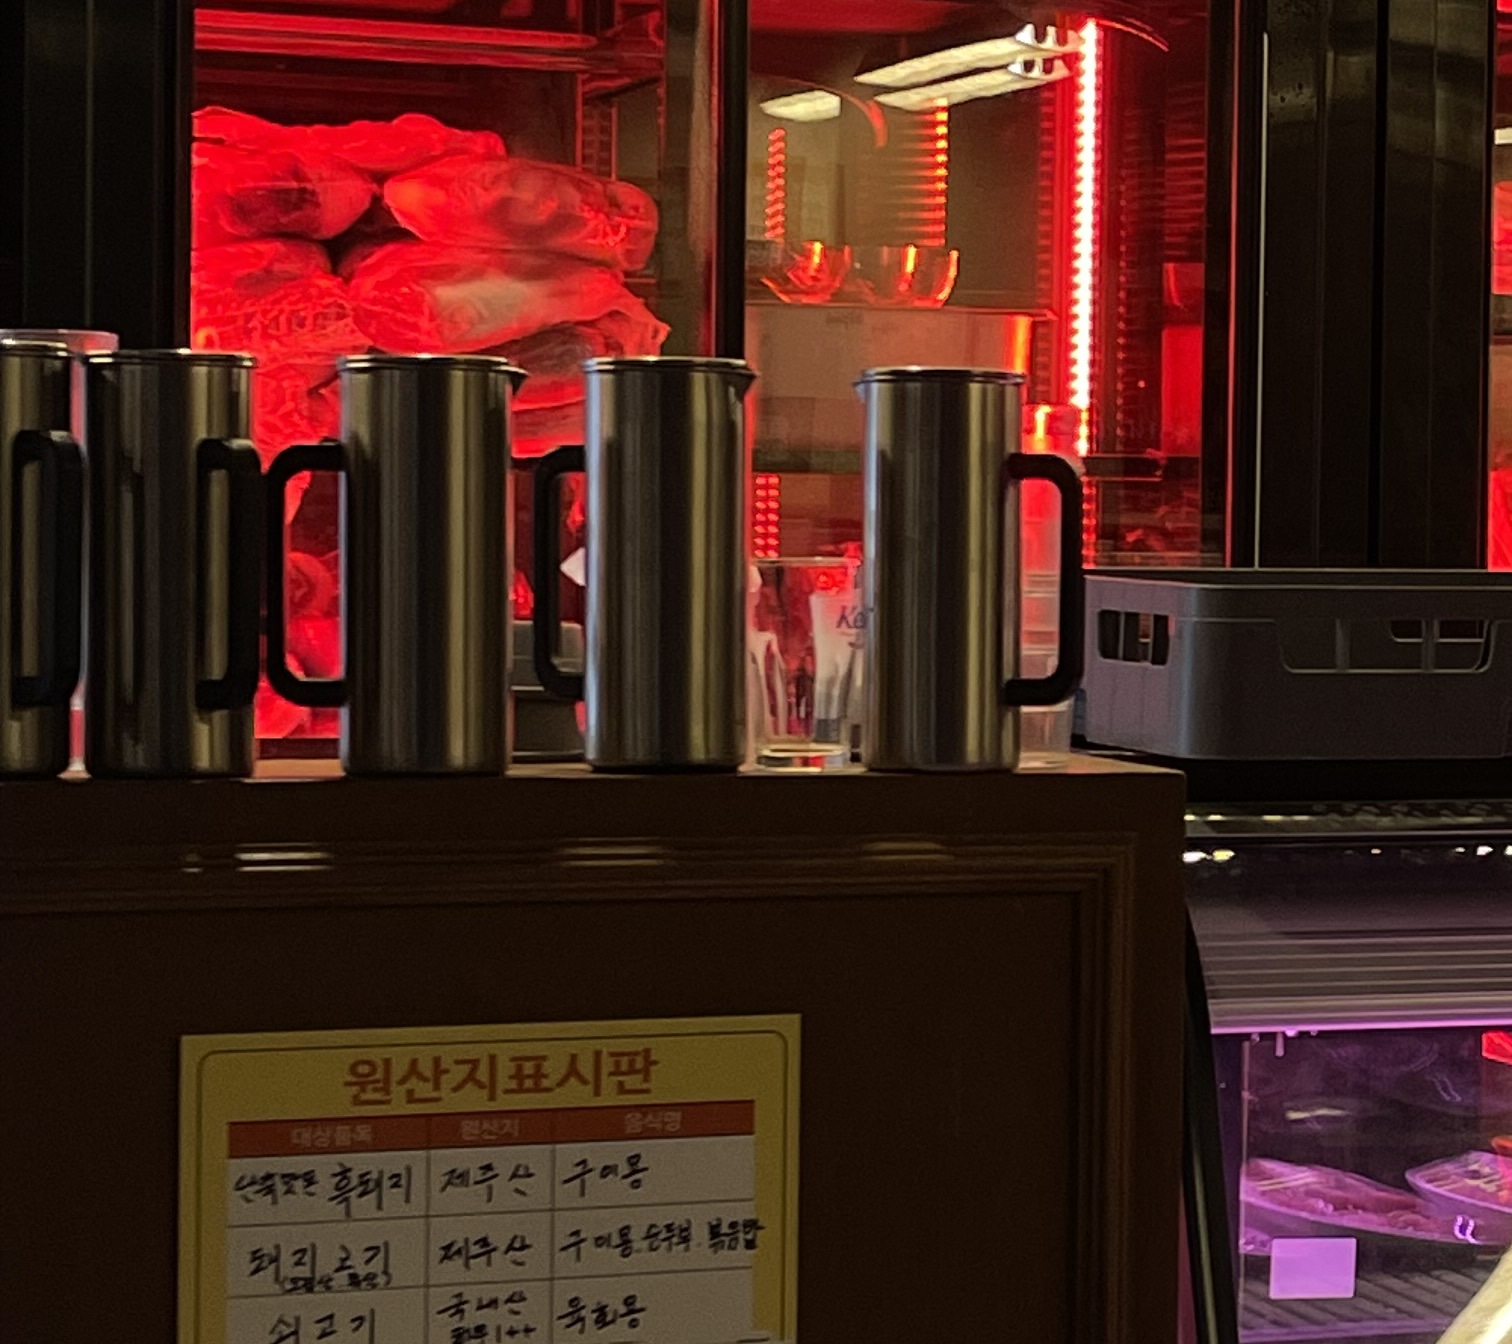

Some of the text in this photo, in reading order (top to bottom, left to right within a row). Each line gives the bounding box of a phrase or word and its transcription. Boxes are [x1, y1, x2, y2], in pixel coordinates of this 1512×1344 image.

[344, 1046, 659, 1108] 원산지표시판
[289, 1124, 373, 1148] 대상품목
[461, 1118, 520, 1141] 원산지
[624, 1110, 683, 1135] 음식명
[328, 1162, 412, 1218] 흑돼지
[440, 1161, 536, 1203] 제주산
[562, 1152, 650, 1197] 구이용
[249, 1240, 391, 1283] 돼지고기
[438, 1233, 534, 1271] 제주산
[436, 1289, 528, 1322] 국내산
[556, 1293, 647, 1335] 육회용
